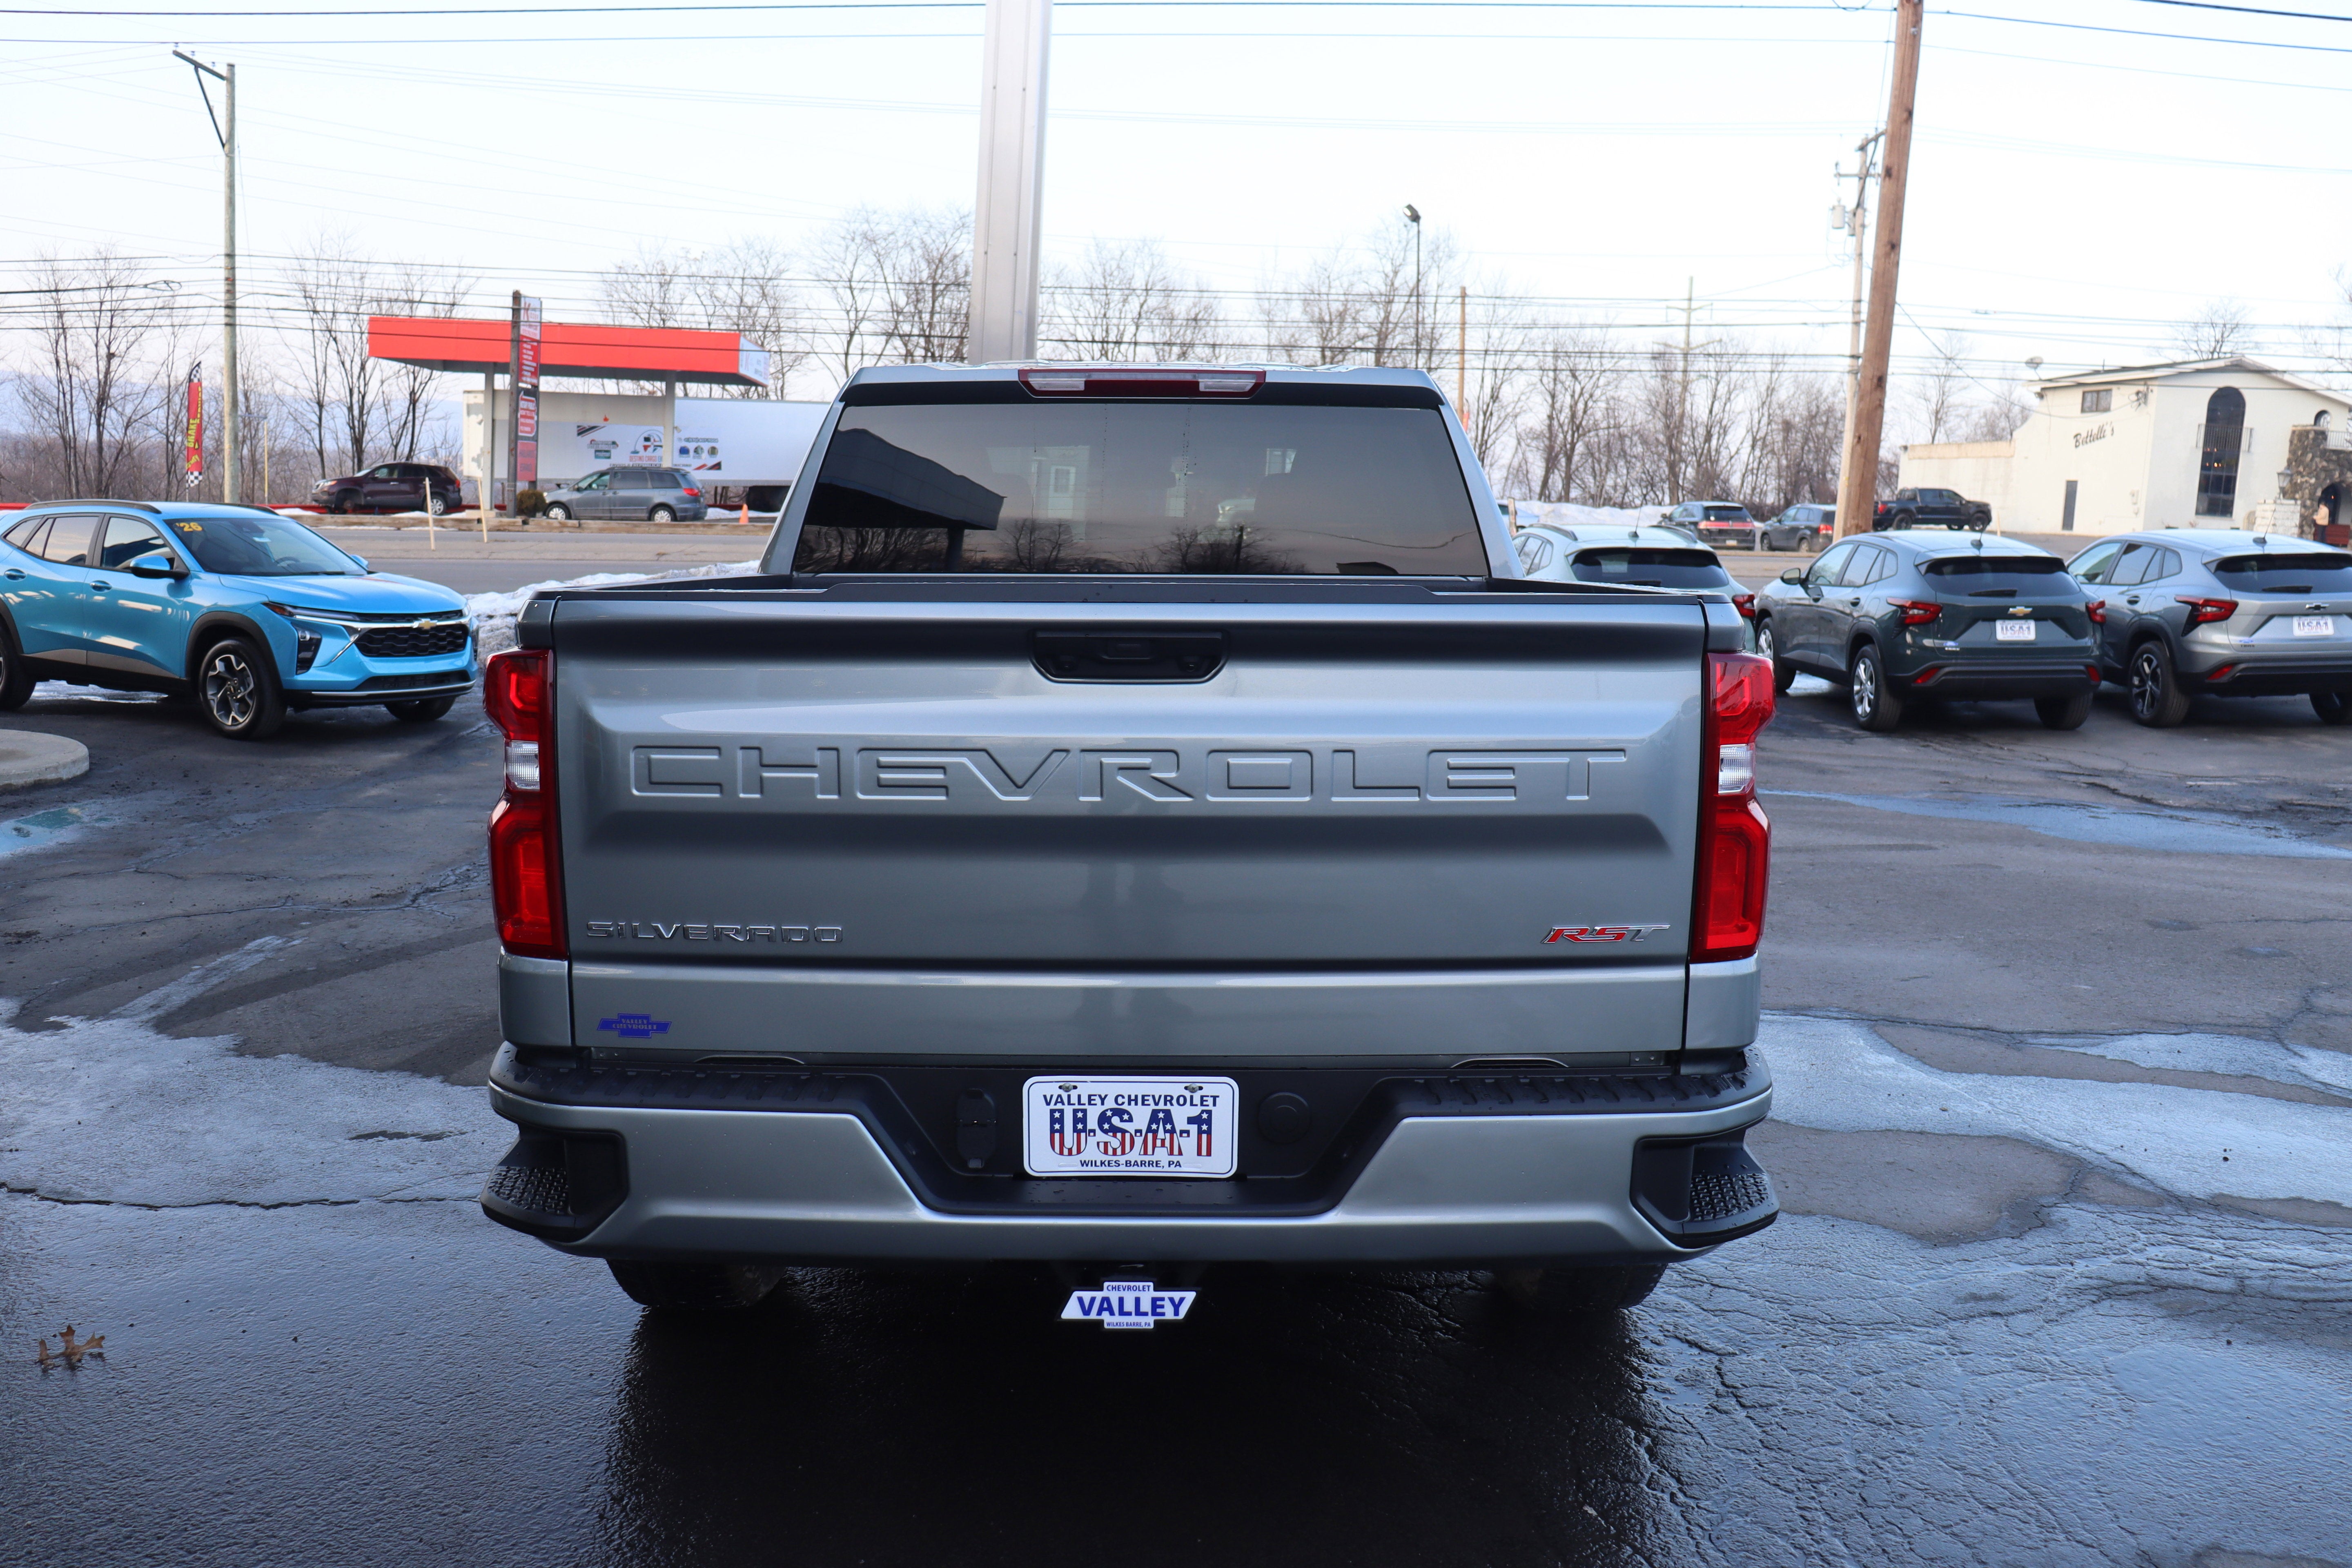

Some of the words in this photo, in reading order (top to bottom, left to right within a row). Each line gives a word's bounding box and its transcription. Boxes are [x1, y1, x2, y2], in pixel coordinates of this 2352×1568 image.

[176, 522, 203, 532] '26
[630, 746, 1628, 803] CHEVROLET
[587, 922, 844, 942] SILVERADO
[1540, 924, 1671, 944] RST
[1043, 1094, 1109, 1106] VALLEY
[1114, 1094, 1220, 1107] CHEVROLET
[1080, 1160, 1165, 1169] WILKES-BARRE,
[1168, 1160, 1182, 1168] PA
[1077, 1296, 1187, 1317] VALLEY
